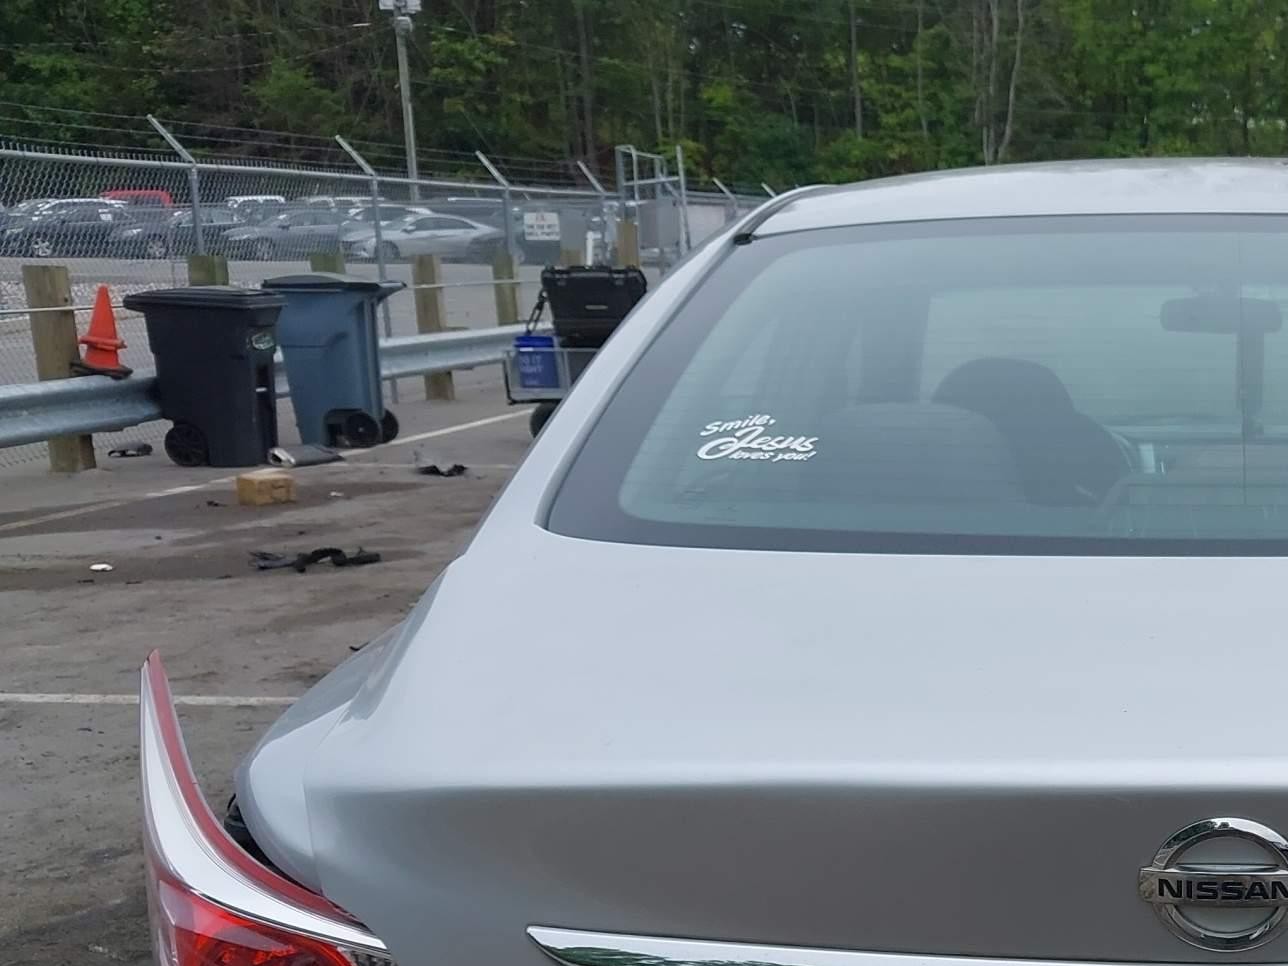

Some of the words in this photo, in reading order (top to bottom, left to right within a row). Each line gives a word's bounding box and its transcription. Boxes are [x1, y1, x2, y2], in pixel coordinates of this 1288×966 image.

[696, 426, 819, 460] Jesus
[727, 450, 774, 460] loves
[771, 451, 817, 462] you!
